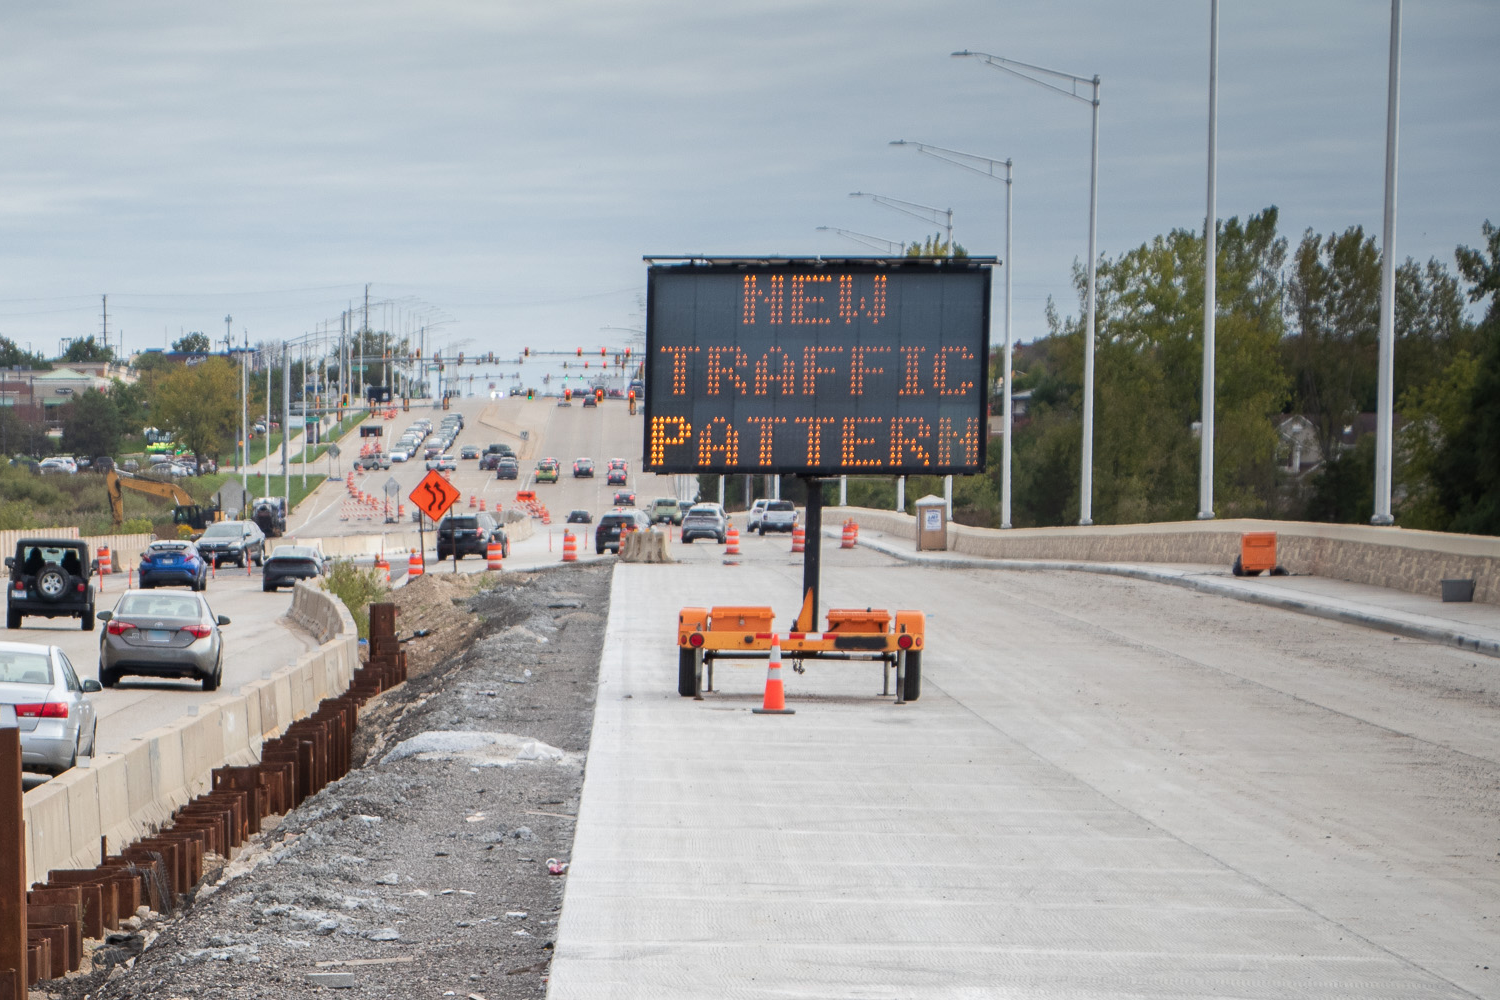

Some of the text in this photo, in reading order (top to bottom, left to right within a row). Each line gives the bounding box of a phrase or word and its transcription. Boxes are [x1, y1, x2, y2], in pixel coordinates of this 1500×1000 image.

[743, 274, 887, 324] NEW
[660, 346, 974, 395] TRAFFIC
[650, 416, 979, 466] PATTERN
